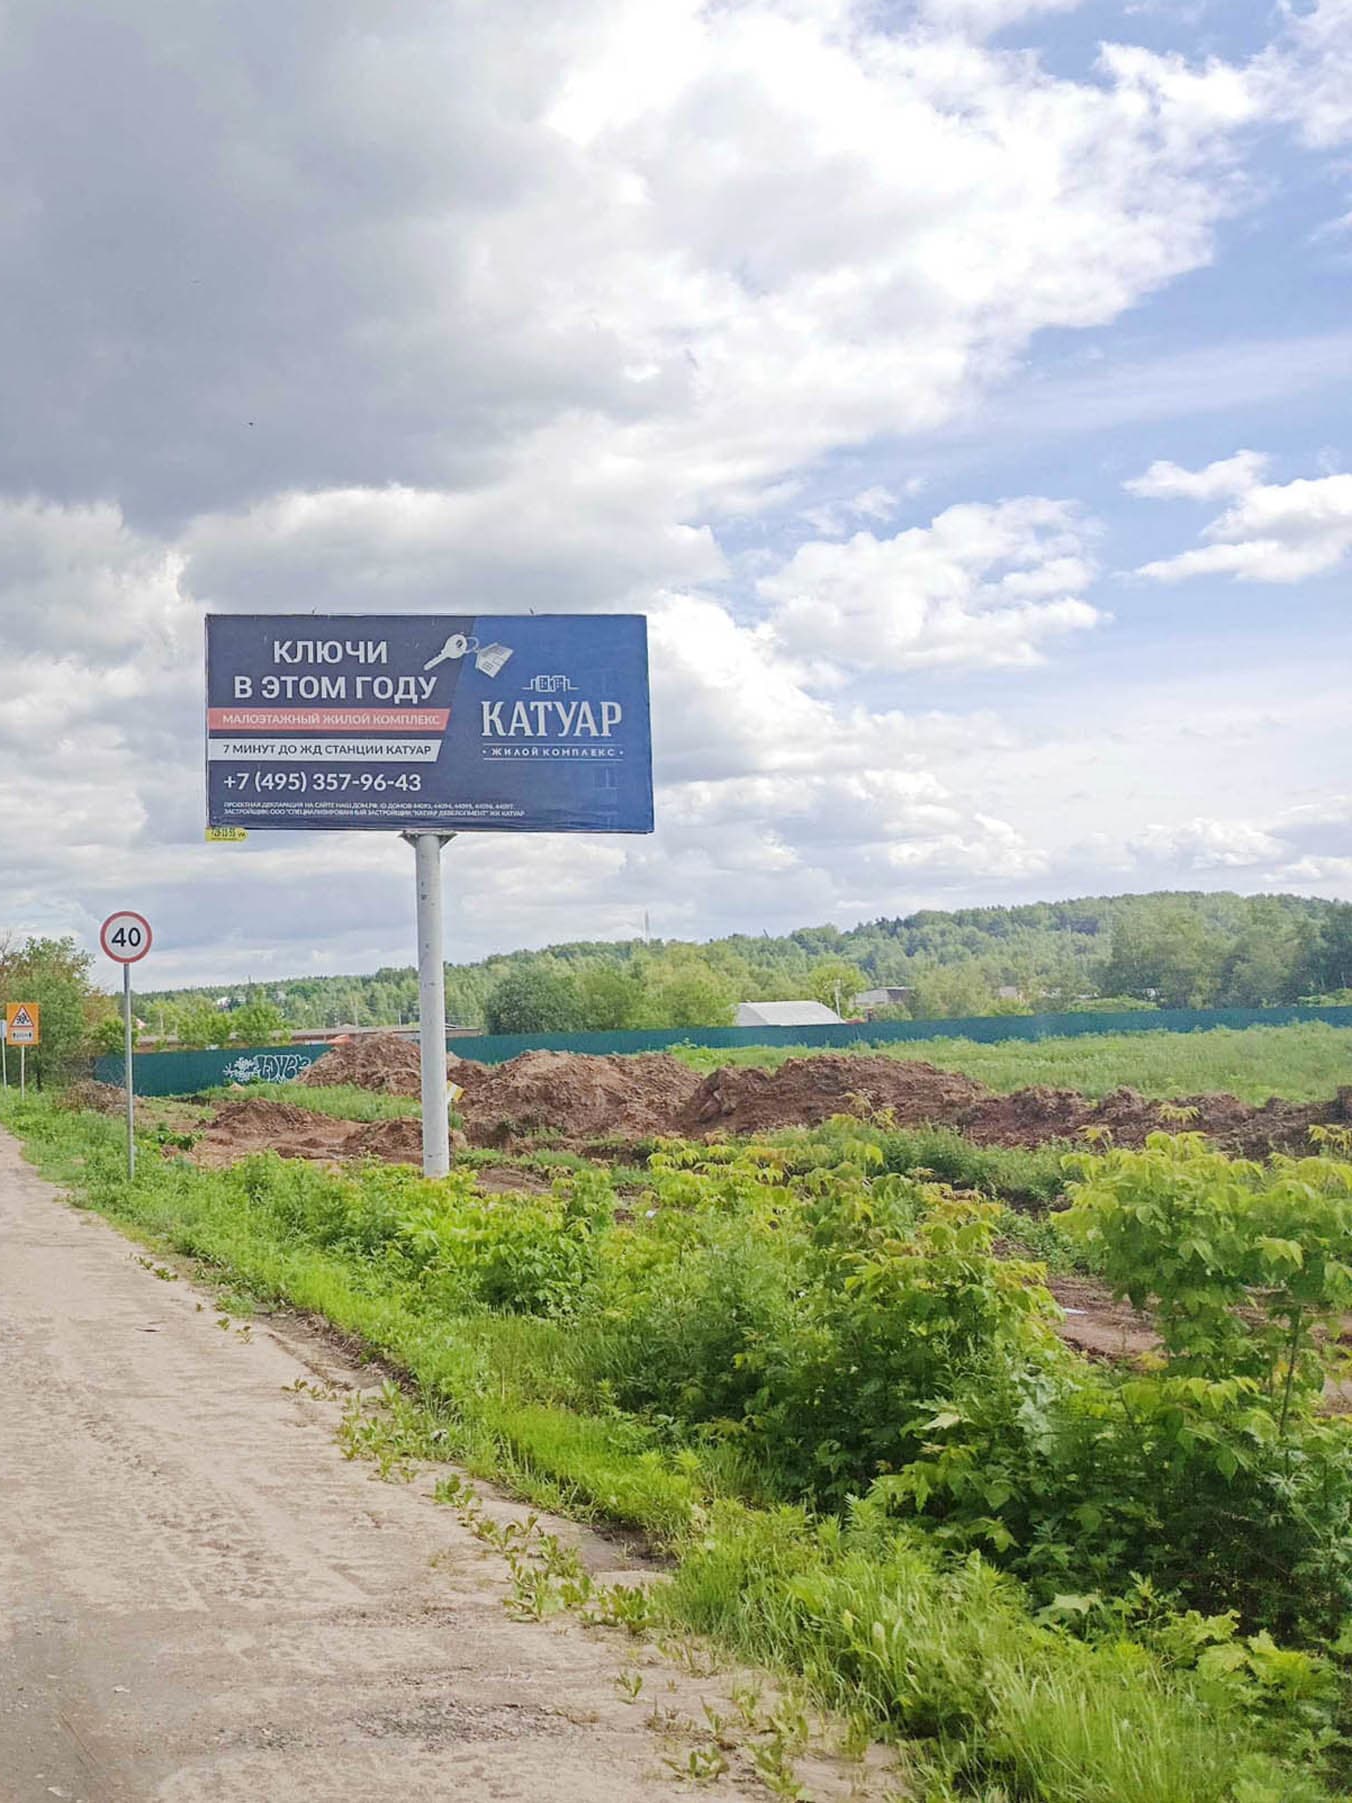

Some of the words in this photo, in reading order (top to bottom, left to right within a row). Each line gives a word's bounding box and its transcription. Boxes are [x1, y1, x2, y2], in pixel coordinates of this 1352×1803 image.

[273, 640, 388, 664] КЛЮЧИ
[234, 676, 253, 699] В
[261, 676, 346, 699] ЭТОМ
[355, 676, 438, 704] ГОДУ
[222, 713, 321, 725] МАЛОЭТАЖНЫЙ
[322, 713, 370, 725] ЖИЛОЙ
[373, 714, 441, 725] КОМПЛЕКС
[481, 701, 623, 737] КАТУАР
[223, 745, 230, 754] 7
[232, 745, 276, 754] МИНУТ
[278, 745, 298, 755] ДО
[300, 745, 323, 755] ЖД
[324, 745, 384, 755] СТАНЦИИ
[386, 745, 432, 755] КАТУАР
[491, 747, 539, 756] ЖИЛОЙ
[543, 748, 616, 757] КОМПЛЕКС
[223, 773, 250, 790] +7
[254, 771, 308, 792] (495)
[312, 773, 422, 791] 357-96-43
[111, 927, 141, 947] 40
